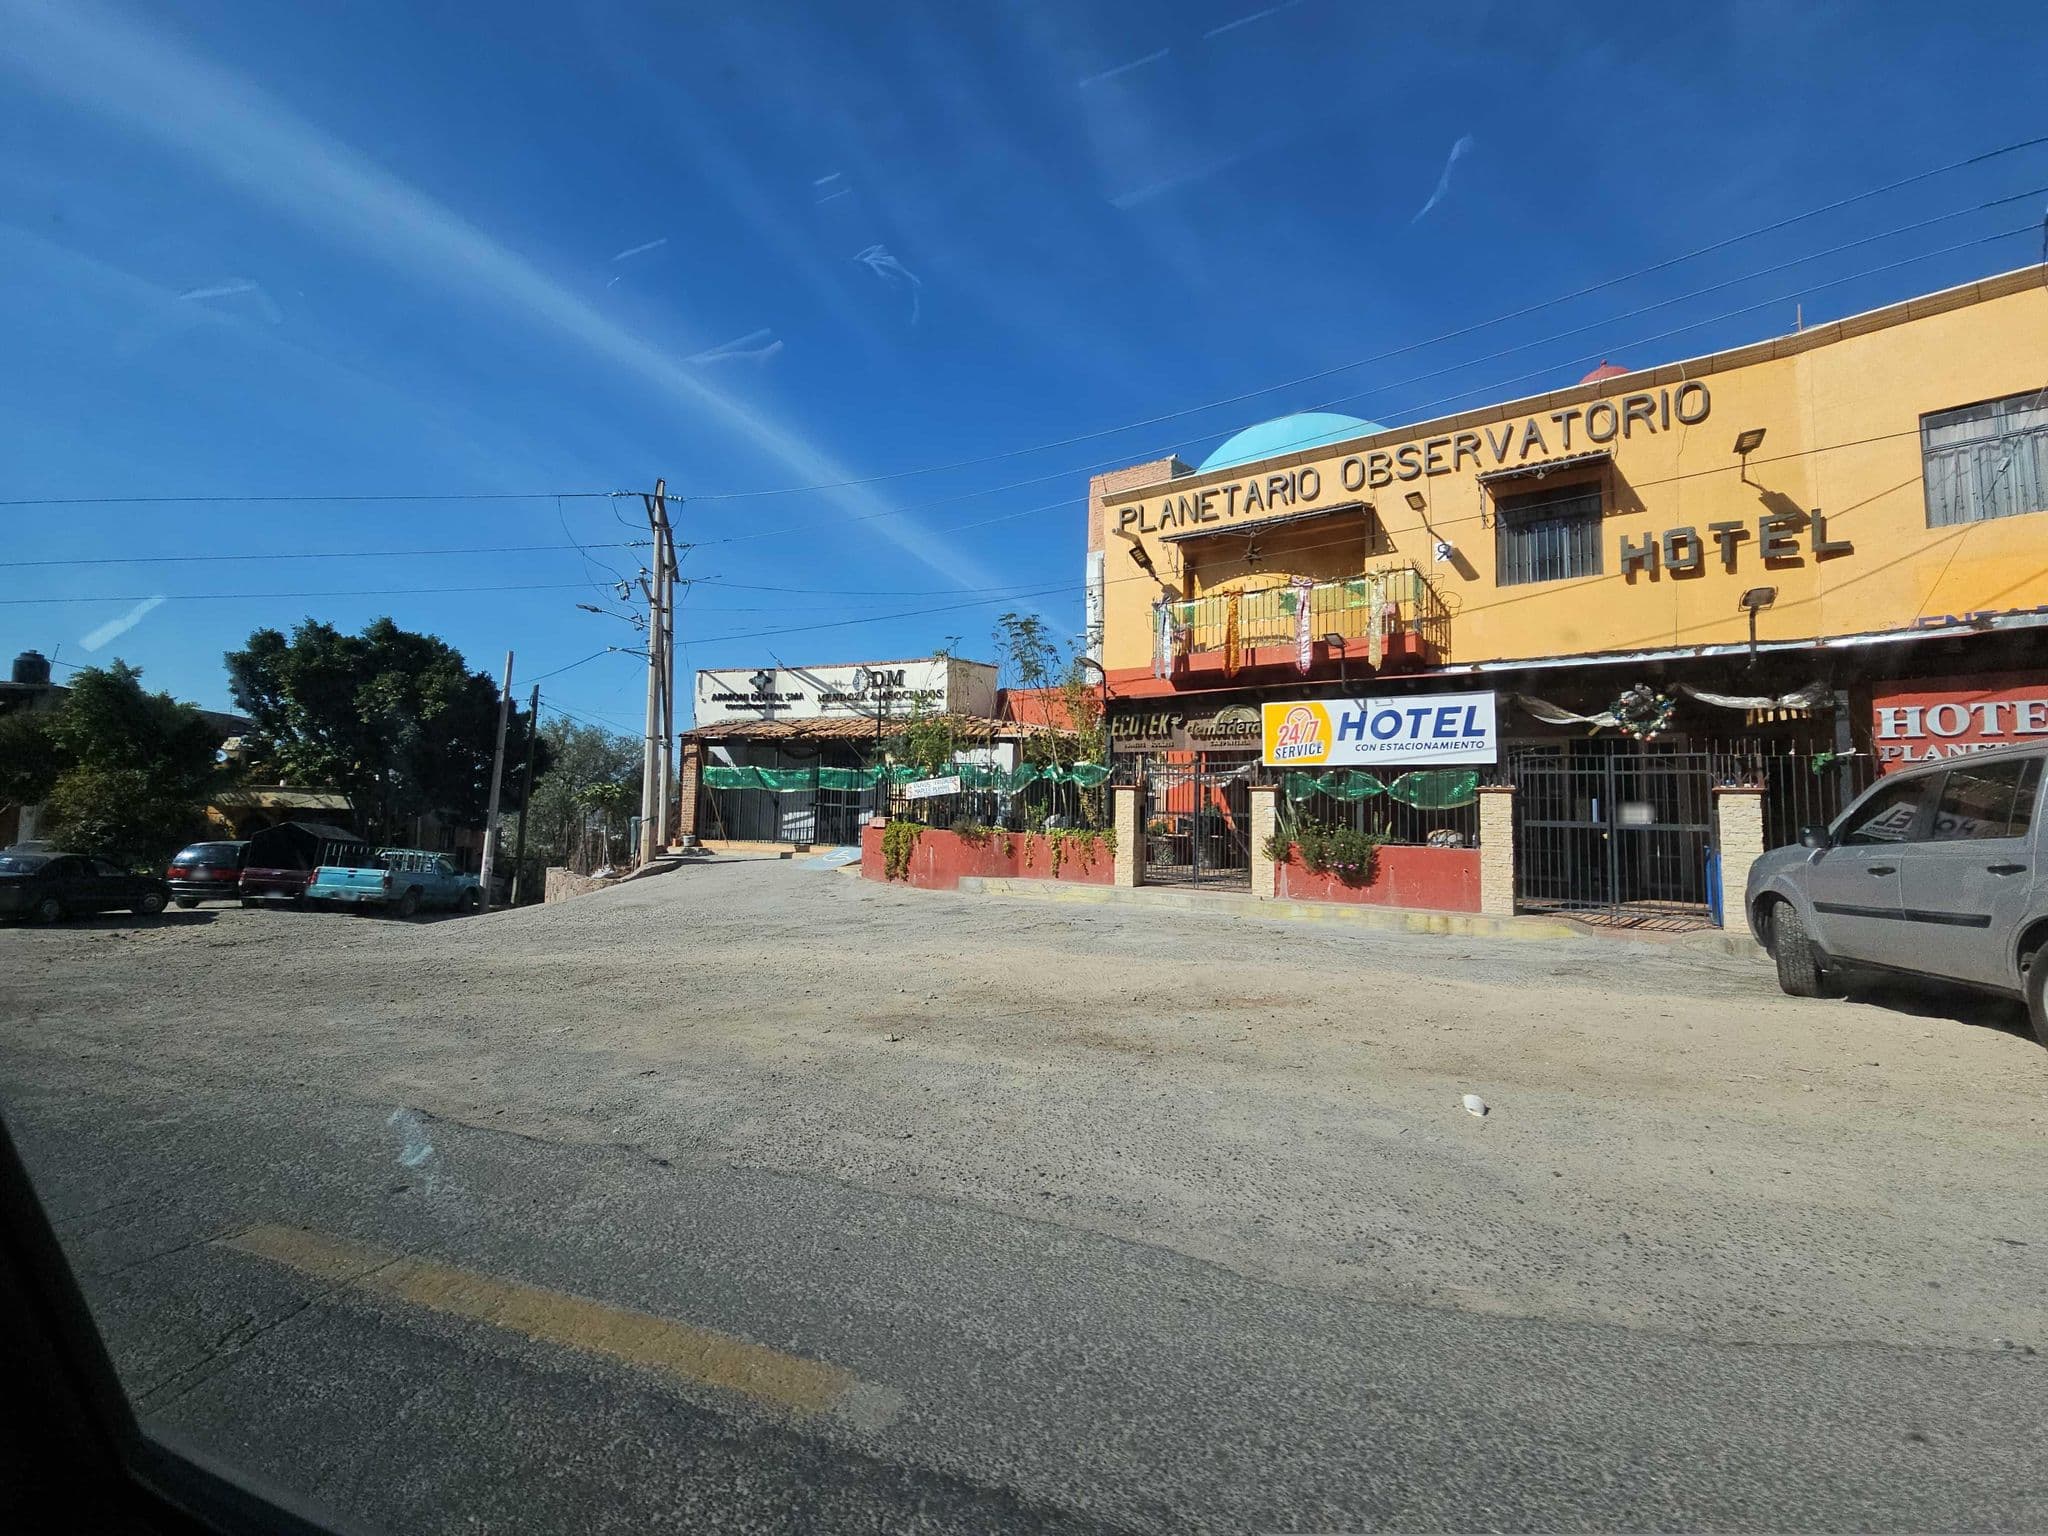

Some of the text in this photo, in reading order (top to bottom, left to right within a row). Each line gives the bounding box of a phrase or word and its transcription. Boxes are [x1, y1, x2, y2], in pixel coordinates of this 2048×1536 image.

[1119, 380, 1711, 533] PLANETARIO OBSERVATORIO
[1620, 508, 1853, 575] HOTEL
[751, 691, 784, 703] DENTAL
[817, 691, 867, 703] MENDOZA
[1278, 720, 1319, 746] 24/7
[1337, 705, 1486, 742] HOTEL
[1275, 742, 1323, 760] SERVICE
[1355, 740, 1485, 752] CON ESTACIONAMIENTO
